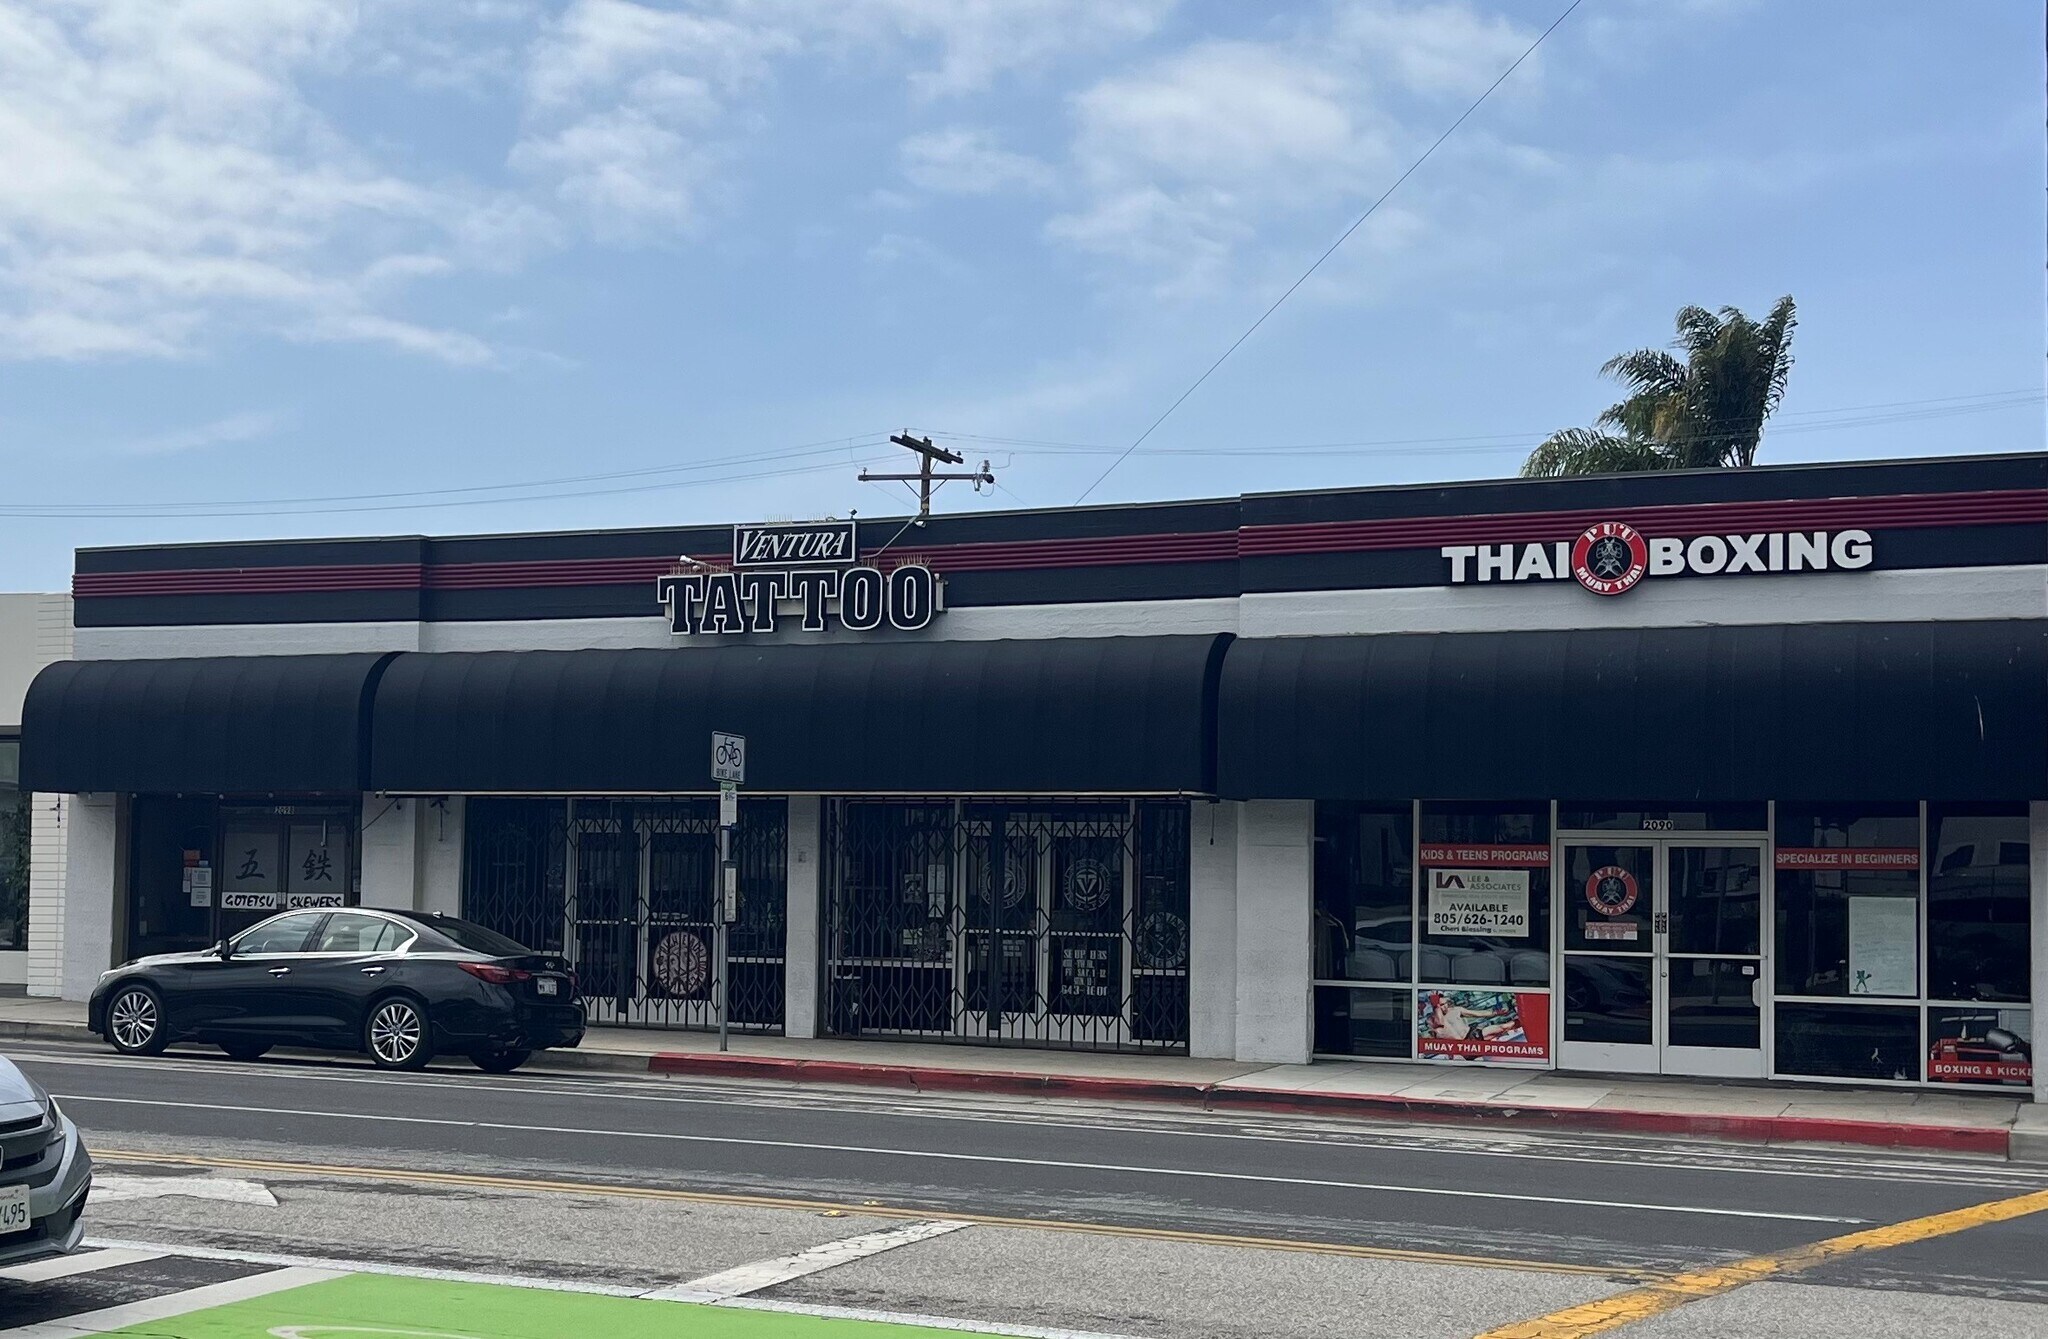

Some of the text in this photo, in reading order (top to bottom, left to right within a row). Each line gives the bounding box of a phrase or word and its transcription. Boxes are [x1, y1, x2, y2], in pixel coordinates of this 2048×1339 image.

[739, 529, 849, 561] VENTURA
[1441, 530, 1873, 582] THAI BOXING
[1576, 564, 1643, 592] MUAY THAI
[657, 565, 933, 636] TATTOO
[1644, 820, 1673, 831] 2090
[1421, 849, 1549, 861] KIDS & TEENS PROGRAMS
[1776, 853, 1918, 864] SPECIALIZE IN BEGINNERS
[236, 848, 265, 880] 五
[1469, 883, 1521, 891] ASSOCIATES
[225, 894, 342, 908] GOTETSU SKEWERS
[1449, 903, 1508, 913] AVAILABLE
[1590, 895, 1635, 914] MUAY THAI
[1434, 912, 1523, 926] 805/626-1240
[1424, 1042, 1544, 1055] MUAY THAI PROGRAMS
[1935, 1064, 1980, 1074] BOXING
[1985, 1066, 1993, 1075] &
[0, 1202, 26, 1226] 495
